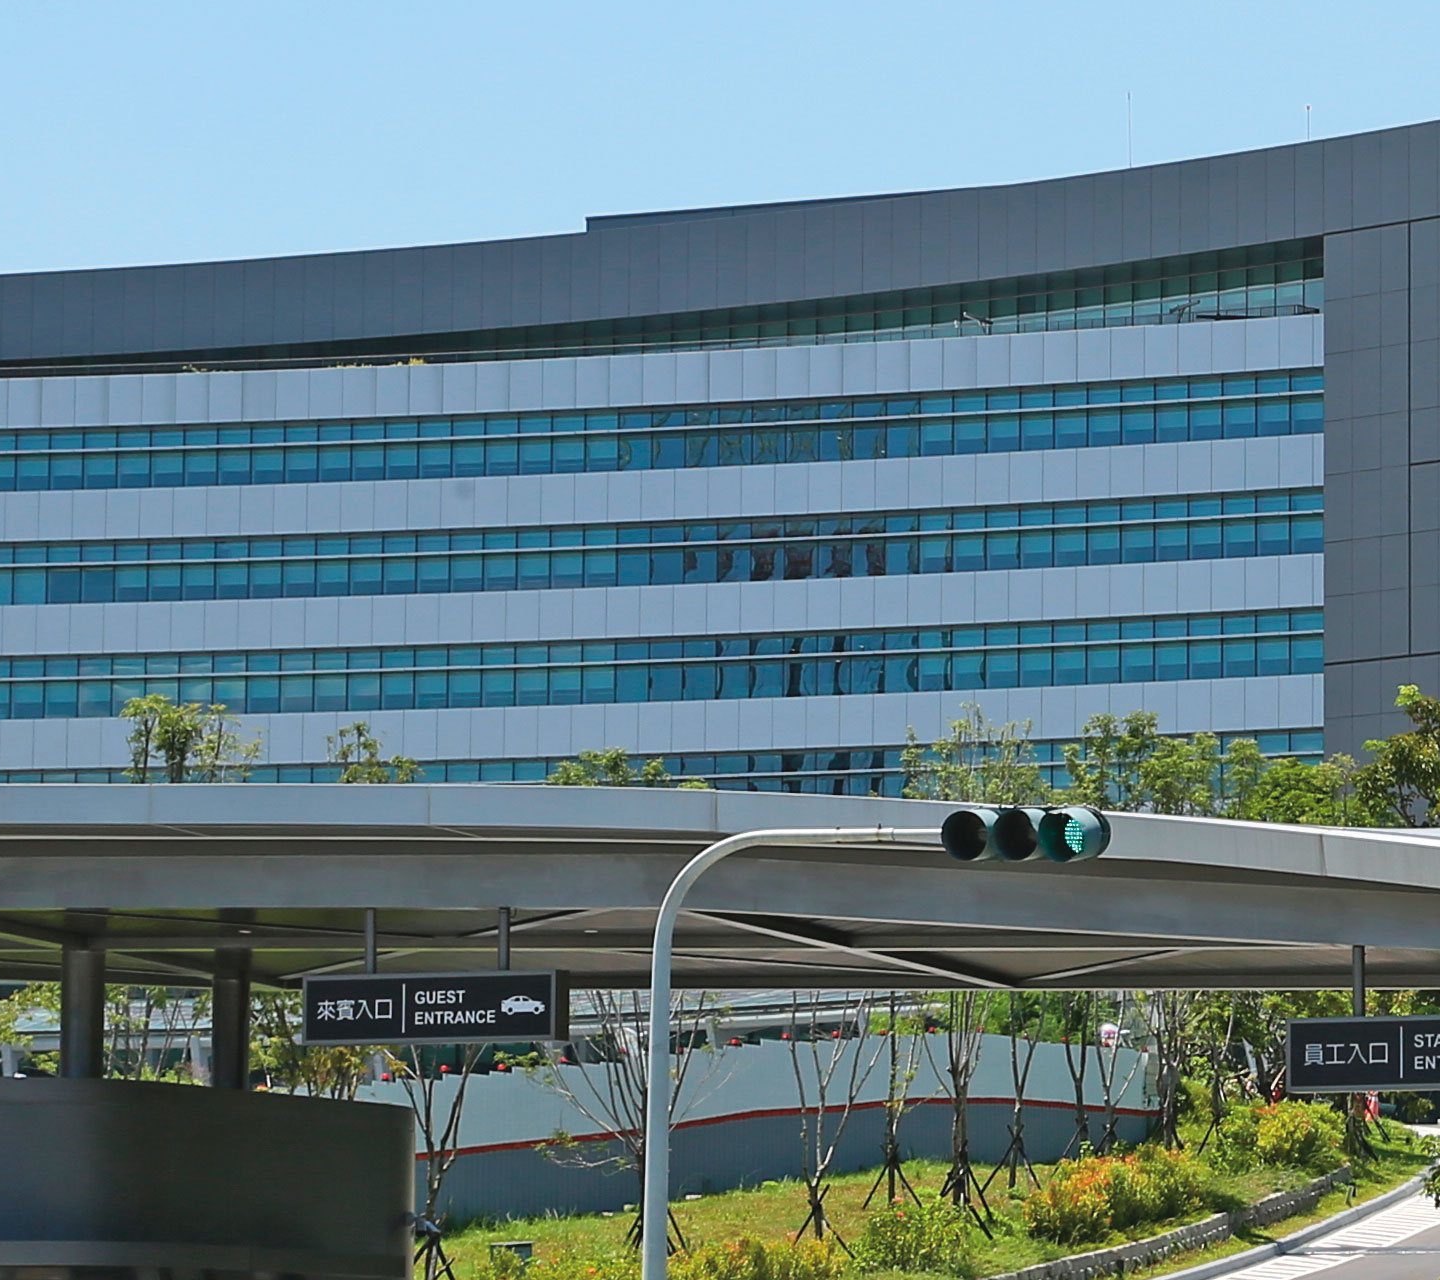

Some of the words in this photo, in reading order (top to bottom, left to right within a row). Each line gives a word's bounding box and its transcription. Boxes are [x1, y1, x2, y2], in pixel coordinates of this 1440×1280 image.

[414, 990, 466, 1005] GUEST
[317, 998, 393, 1021] 來賓入口
[414, 1010, 496, 1026] ENTRANCE
[1304, 1042, 1389, 1066] 員工入口
